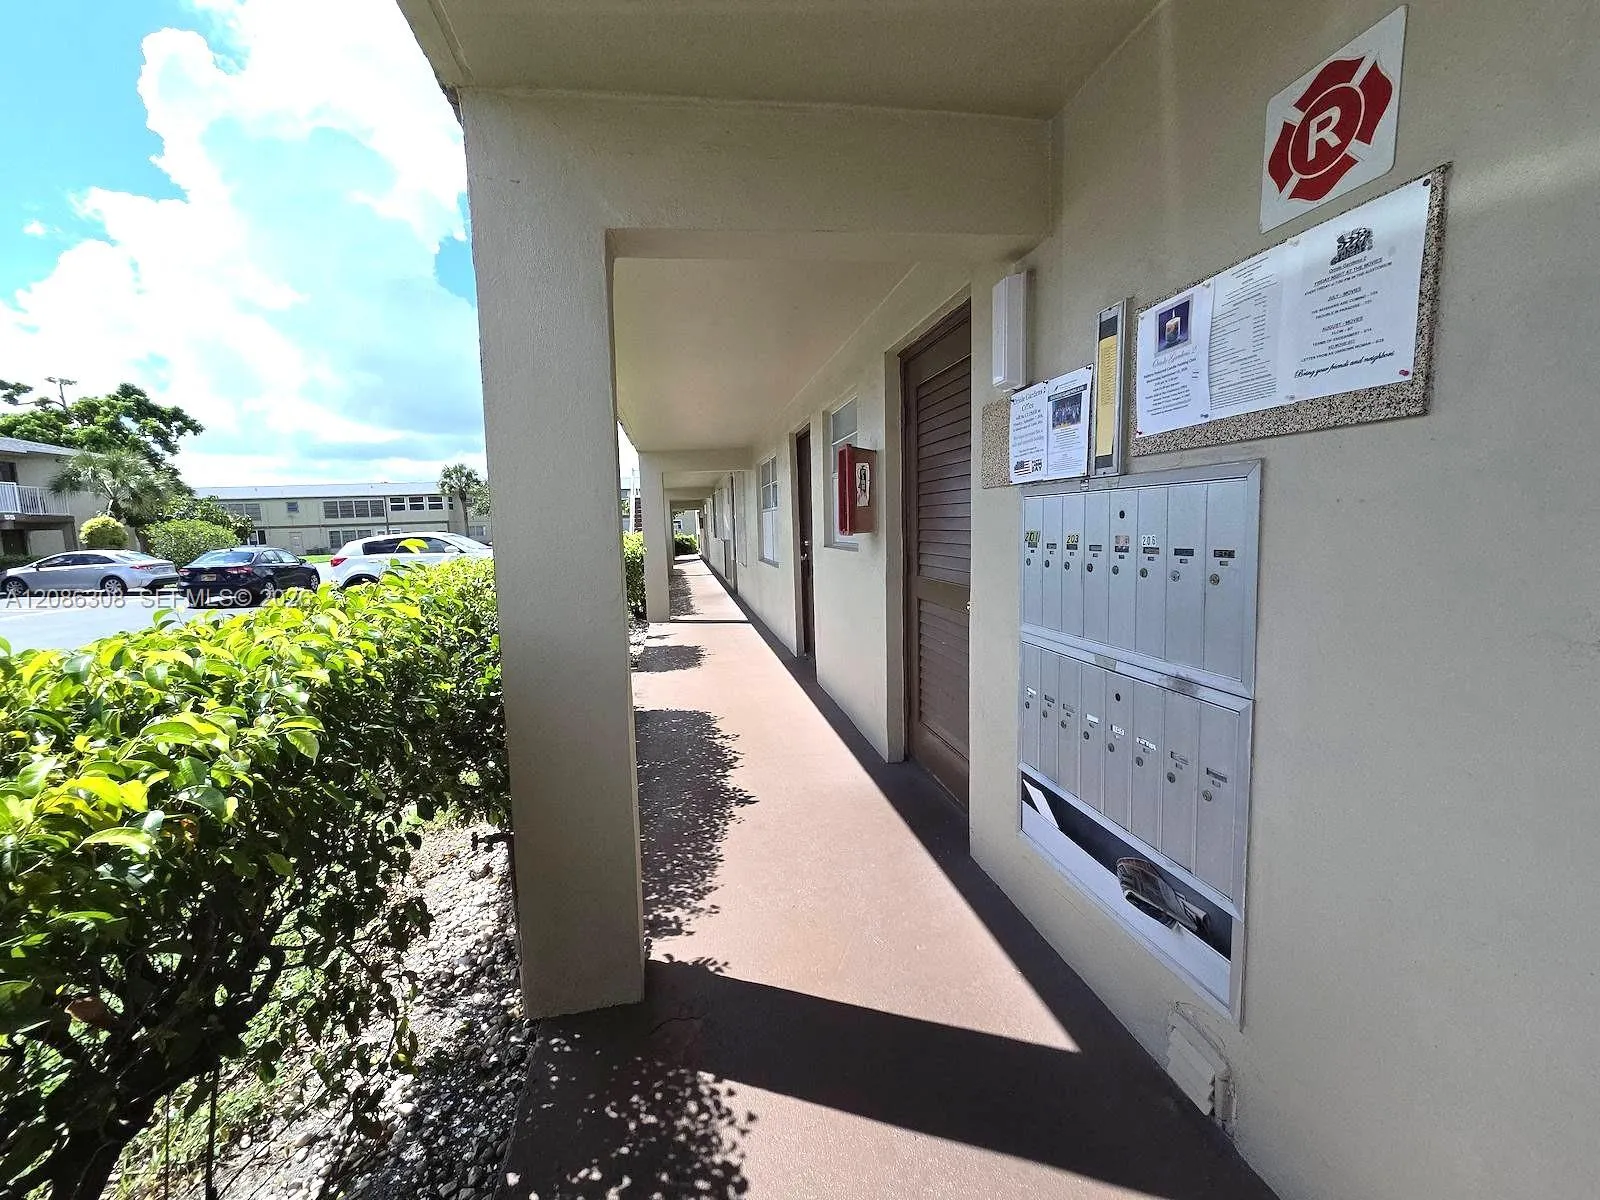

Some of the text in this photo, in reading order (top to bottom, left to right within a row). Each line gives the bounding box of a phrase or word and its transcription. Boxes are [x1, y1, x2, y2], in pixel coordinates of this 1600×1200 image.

[1306, 105, 1342, 162] R
[1350, 355, 1364, 366] and
[1066, 534, 1079, 544] 203
[1142, 535, 1156, 546] 206
